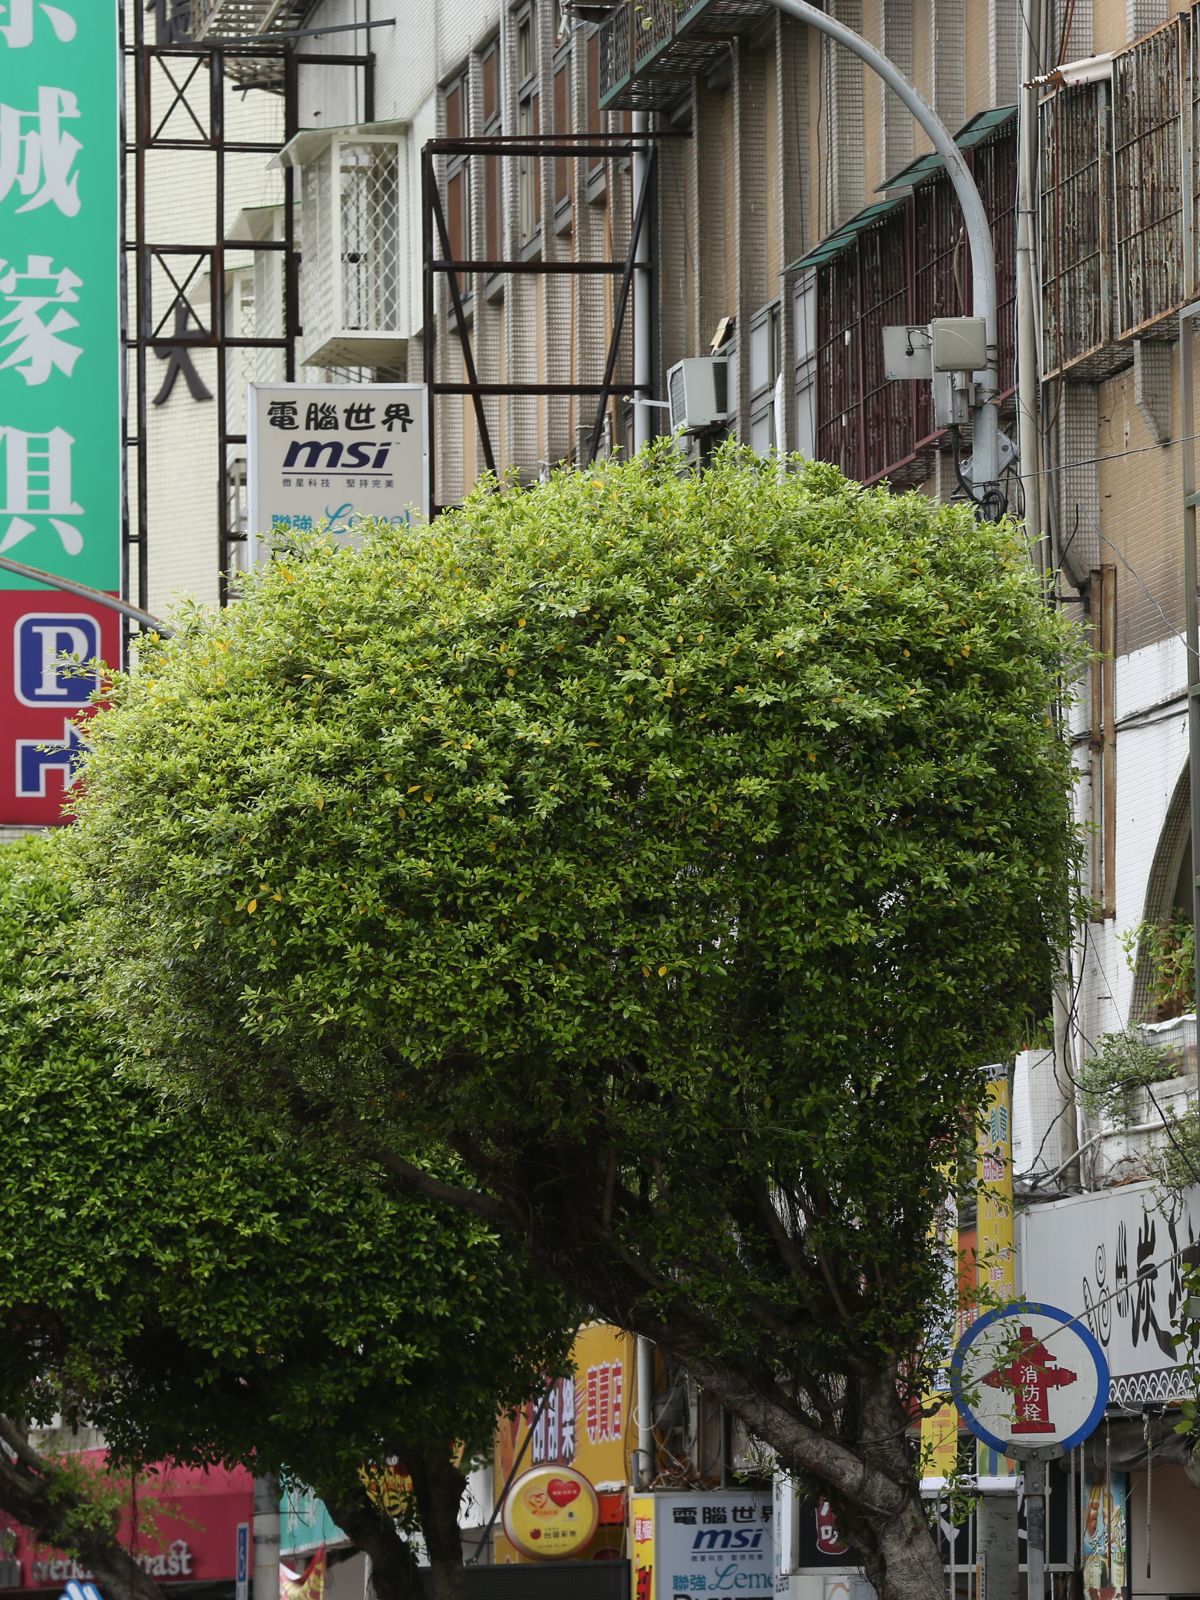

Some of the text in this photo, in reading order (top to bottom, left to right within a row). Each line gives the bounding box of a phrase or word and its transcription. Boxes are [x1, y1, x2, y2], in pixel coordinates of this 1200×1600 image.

[267, 401, 414, 432] 電腦世界
[282, 440, 393, 468] msi
[32, 626, 89, 695] P
[587, 1358, 623, 1446] 專賣店
[1020, 1365, 1042, 1421] 消防栓
[692, 1529, 763, 1549] msi
[672, 1575, 706, 1591] 聯強
